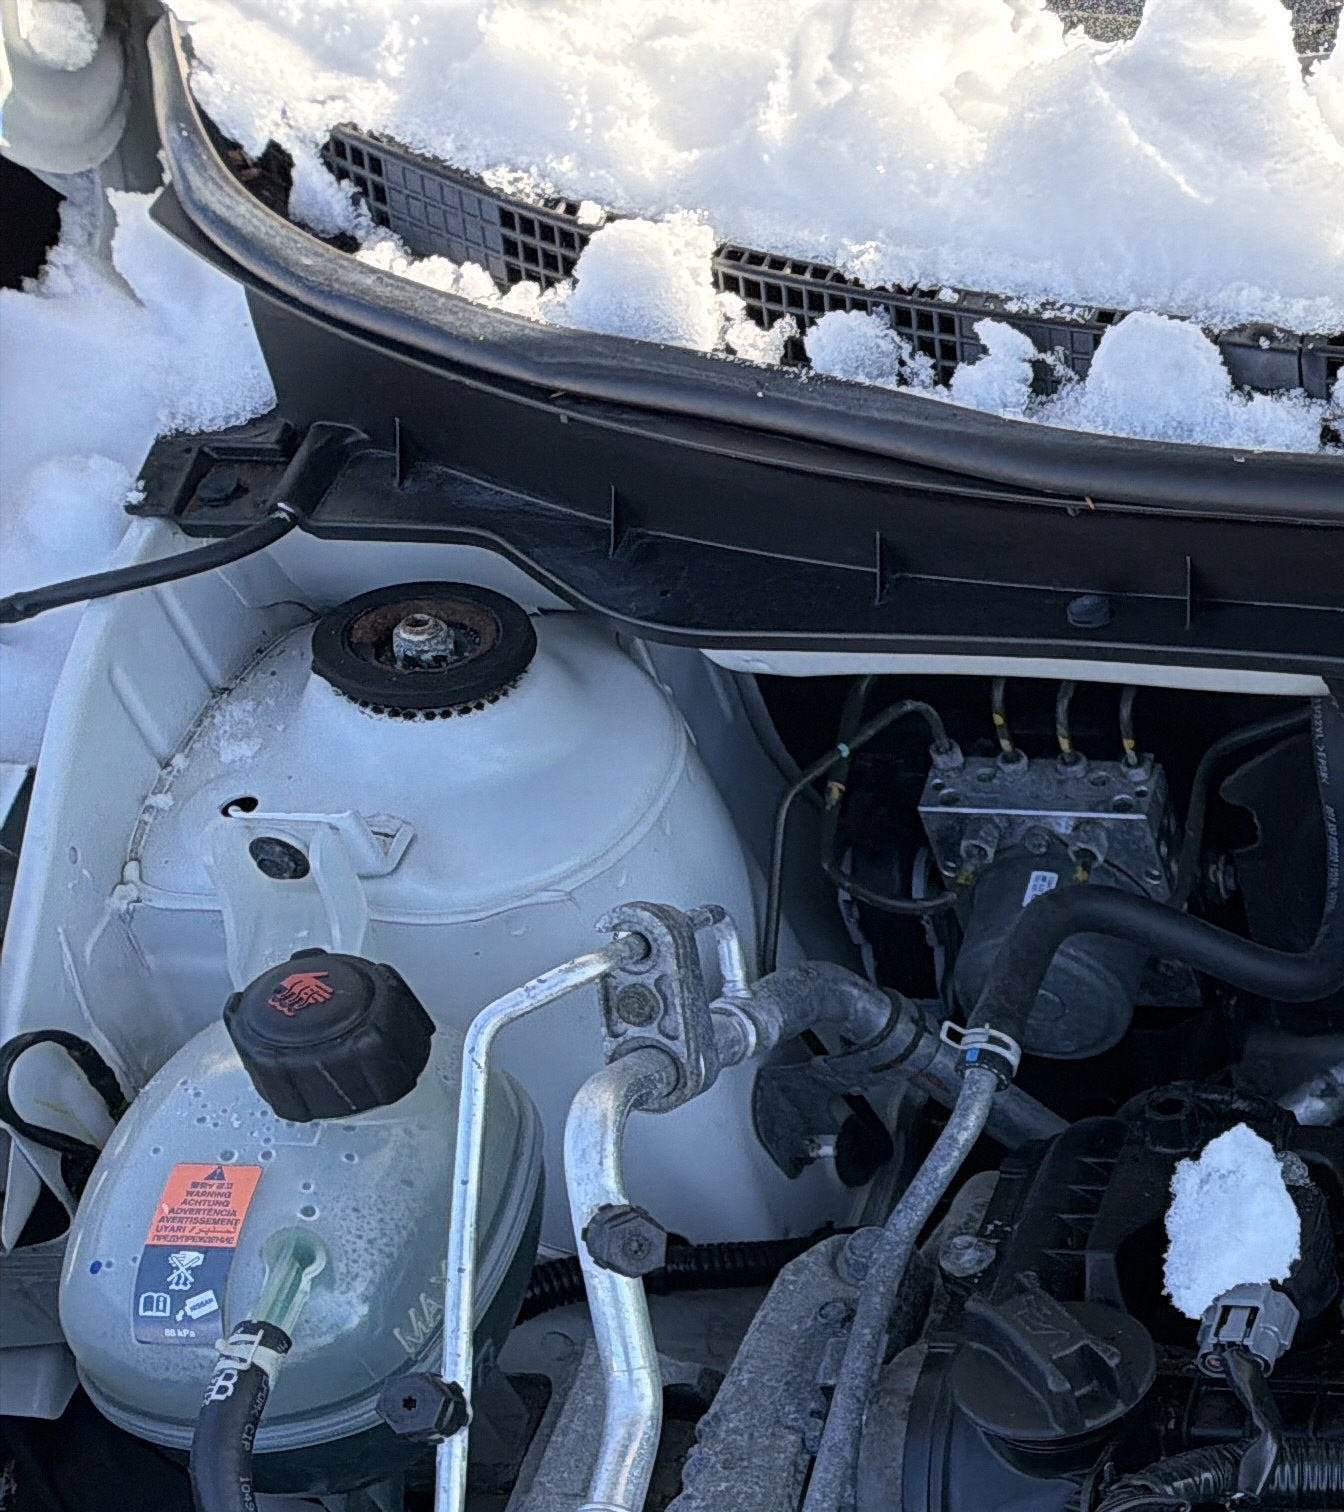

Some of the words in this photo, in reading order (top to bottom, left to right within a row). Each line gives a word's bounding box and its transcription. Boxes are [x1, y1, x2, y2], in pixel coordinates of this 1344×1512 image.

[185, 1190, 232, 1198] WARNING
[180, 1198, 230, 1207] ACHTUNG
[158, 1215, 240, 1226] AVERTISSEMENT
[156, 1224, 186, 1233] UYARI
